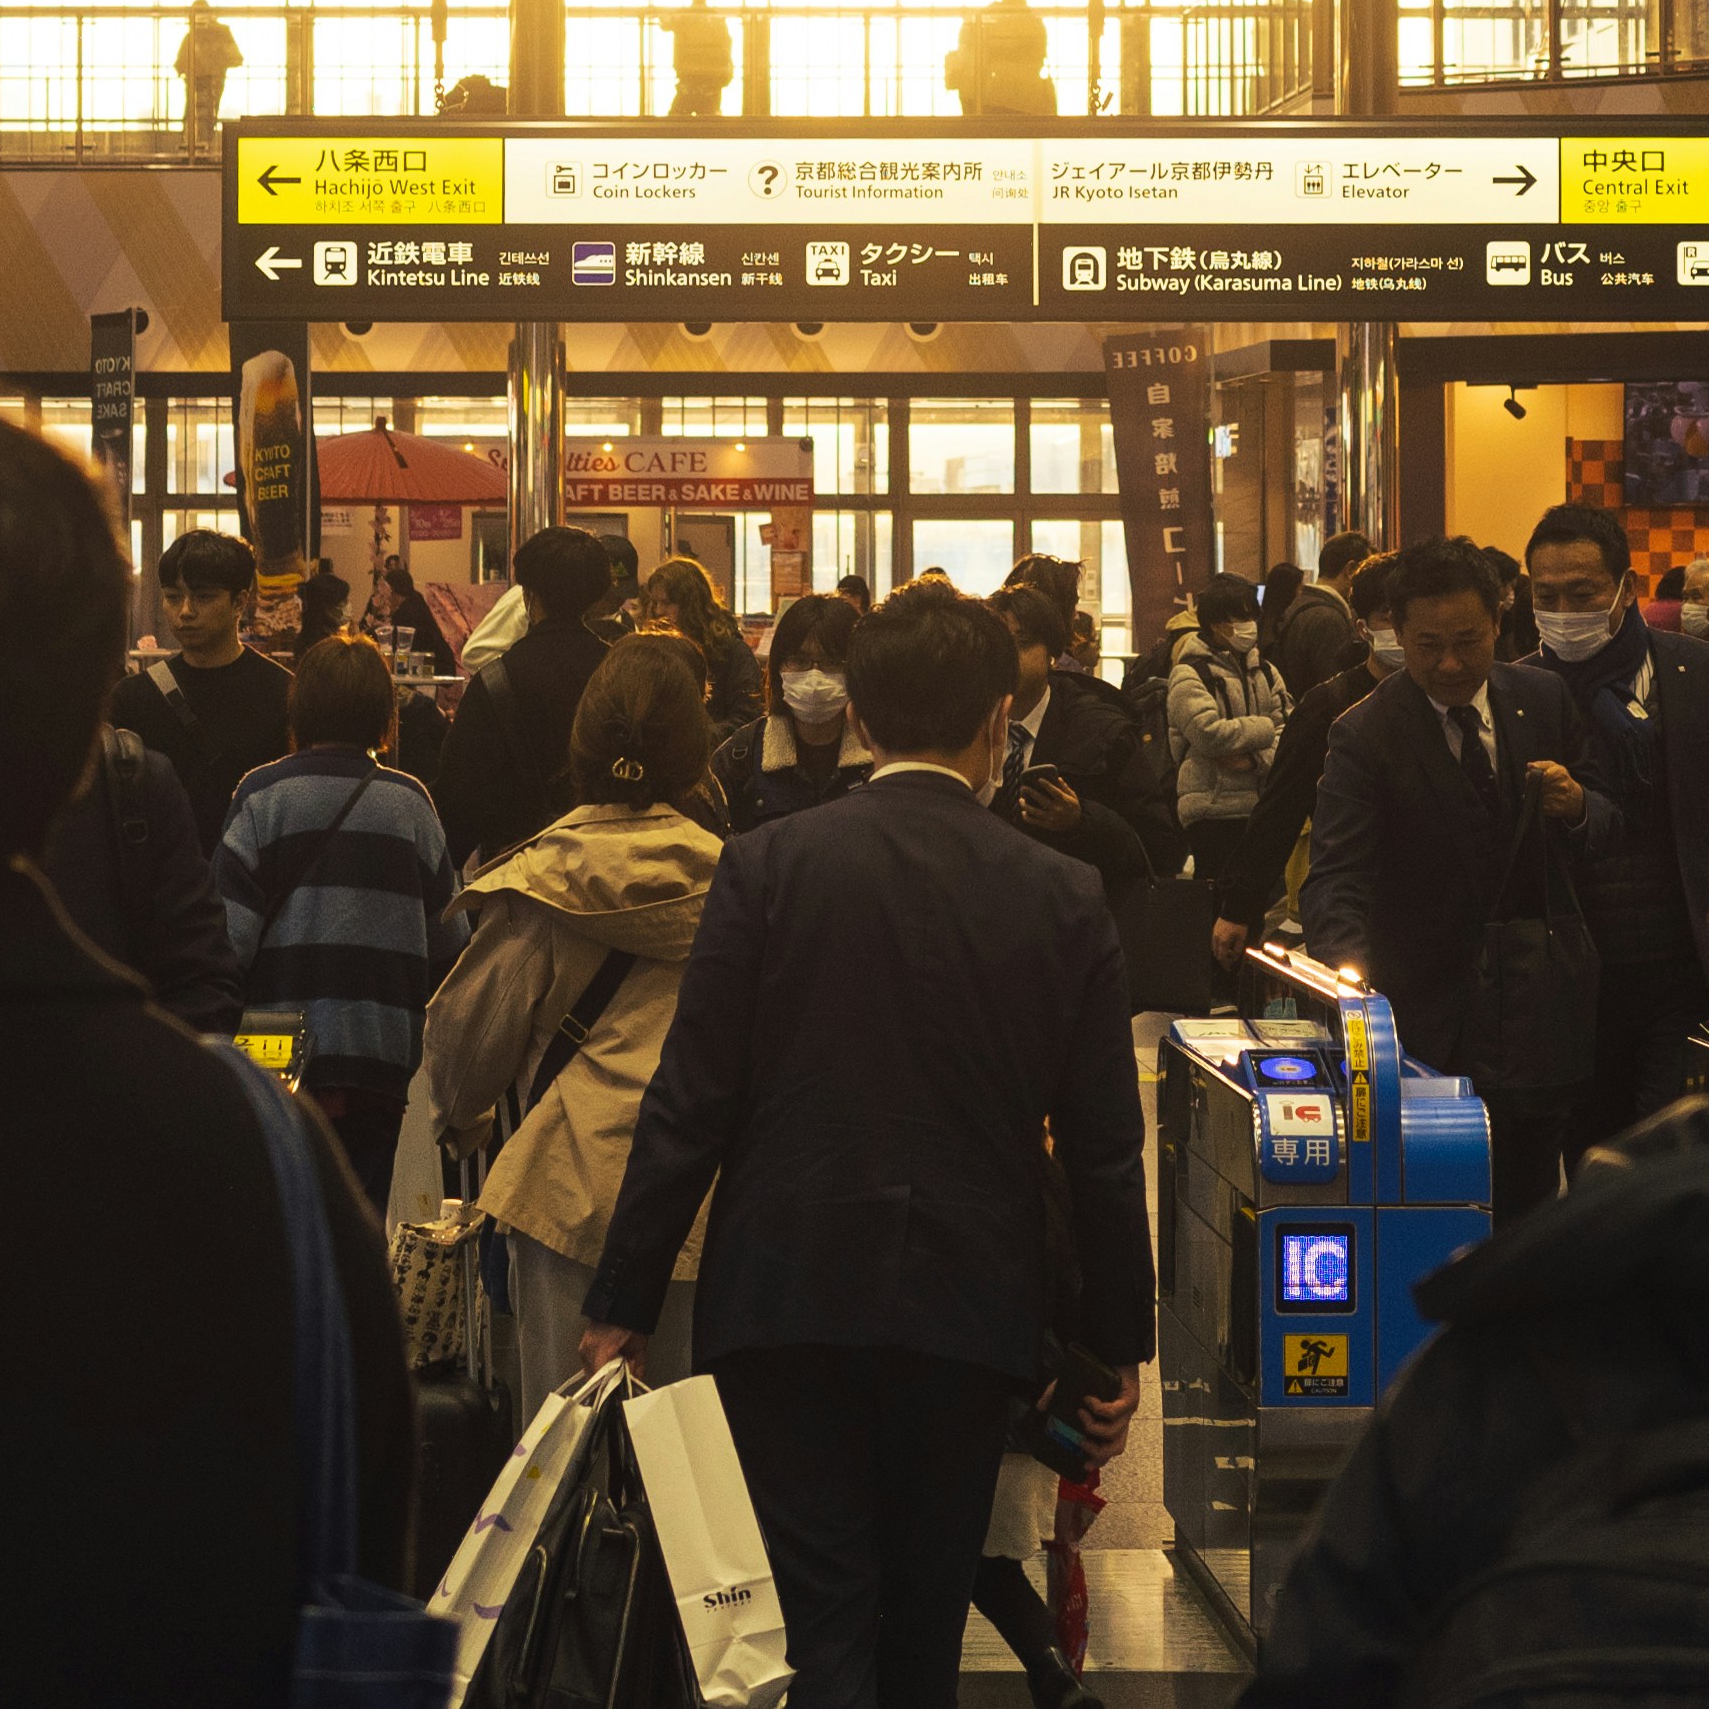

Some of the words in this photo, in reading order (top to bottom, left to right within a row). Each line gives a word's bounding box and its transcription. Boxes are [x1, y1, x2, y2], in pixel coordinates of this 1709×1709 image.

[316, 150, 426, 172] 八条西口
[1584, 150, 1664, 172] 中央口
[593, 162, 727, 180] コインロッカー
[795, 162, 982, 181] 京都総合観光案内所
[993, 169, 1027, 182] 안내소
[1051, 162, 1274, 181] ジェイアール京都伊勢丹
[1343, 162, 1463, 180] エレベーター
[315, 179, 383, 199] Hachijō
[390, 180, 435, 195] West
[443, 179, 476, 195] Exit
[593, 185, 629, 199] Coin
[635, 185, 696, 199] Lockers
[796, 185, 847, 199] Tourist
[852, 185, 943, 199] Information
[1053, 186, 1069, 199] JR
[1075, 186, 1123, 202] Kyoto
[1130, 186, 1178, 199] Isetan
[1343, 185, 1409, 199] Elevator
[1583, 179, 1648, 195] Central
[1655, 179, 1689, 195] Exit
[315, 201, 354, 214] 하치조
[390, 201, 416, 214] 출구
[427, 201, 486, 214] 八条西口
[1584, 200, 1610, 213] 중앙
[368, 242, 473, 265] 近鉄電車
[626, 242, 705, 266] 新幹線
[811, 245, 844, 255] TAXI
[860, 243, 959, 265] タクシー
[1541, 243, 1590, 265] バス
[742, 252, 779, 266] 신칸센
[969, 252, 993, 266] 택시
[1600, 253, 1625, 265] 버스
[368, 270, 445, 286] Kintetsu
[451, 270, 489, 286] Line
[626, 269, 731, 286] Shinkansen
[860, 270, 896, 286] Taxi
[1117, 274, 1190, 295] Subway
[1194, 274, 1291, 293] (Karasuma
[1298, 274, 1342, 293] Line)
[1541, 270, 1573, 286] Bus
[1601, 273, 1654, 286] 公共汽车
[624, 451, 708, 473] CAFE
[255, 464, 290, 482] CRAFT
[257, 484, 289, 501] BEER
[566, 484, 602, 501] AFT
[609, 484, 665, 501] BEER
[668, 490, 679, 501] &
[681, 484, 740, 501] SAKE
[743, 490, 753, 501] &
[753, 484, 809, 501] WINE
[1271, 1138, 1330, 1166] 専用
[1289, 1241, 1344, 1296] IC
[703, 1586, 751, 1608] Shin
